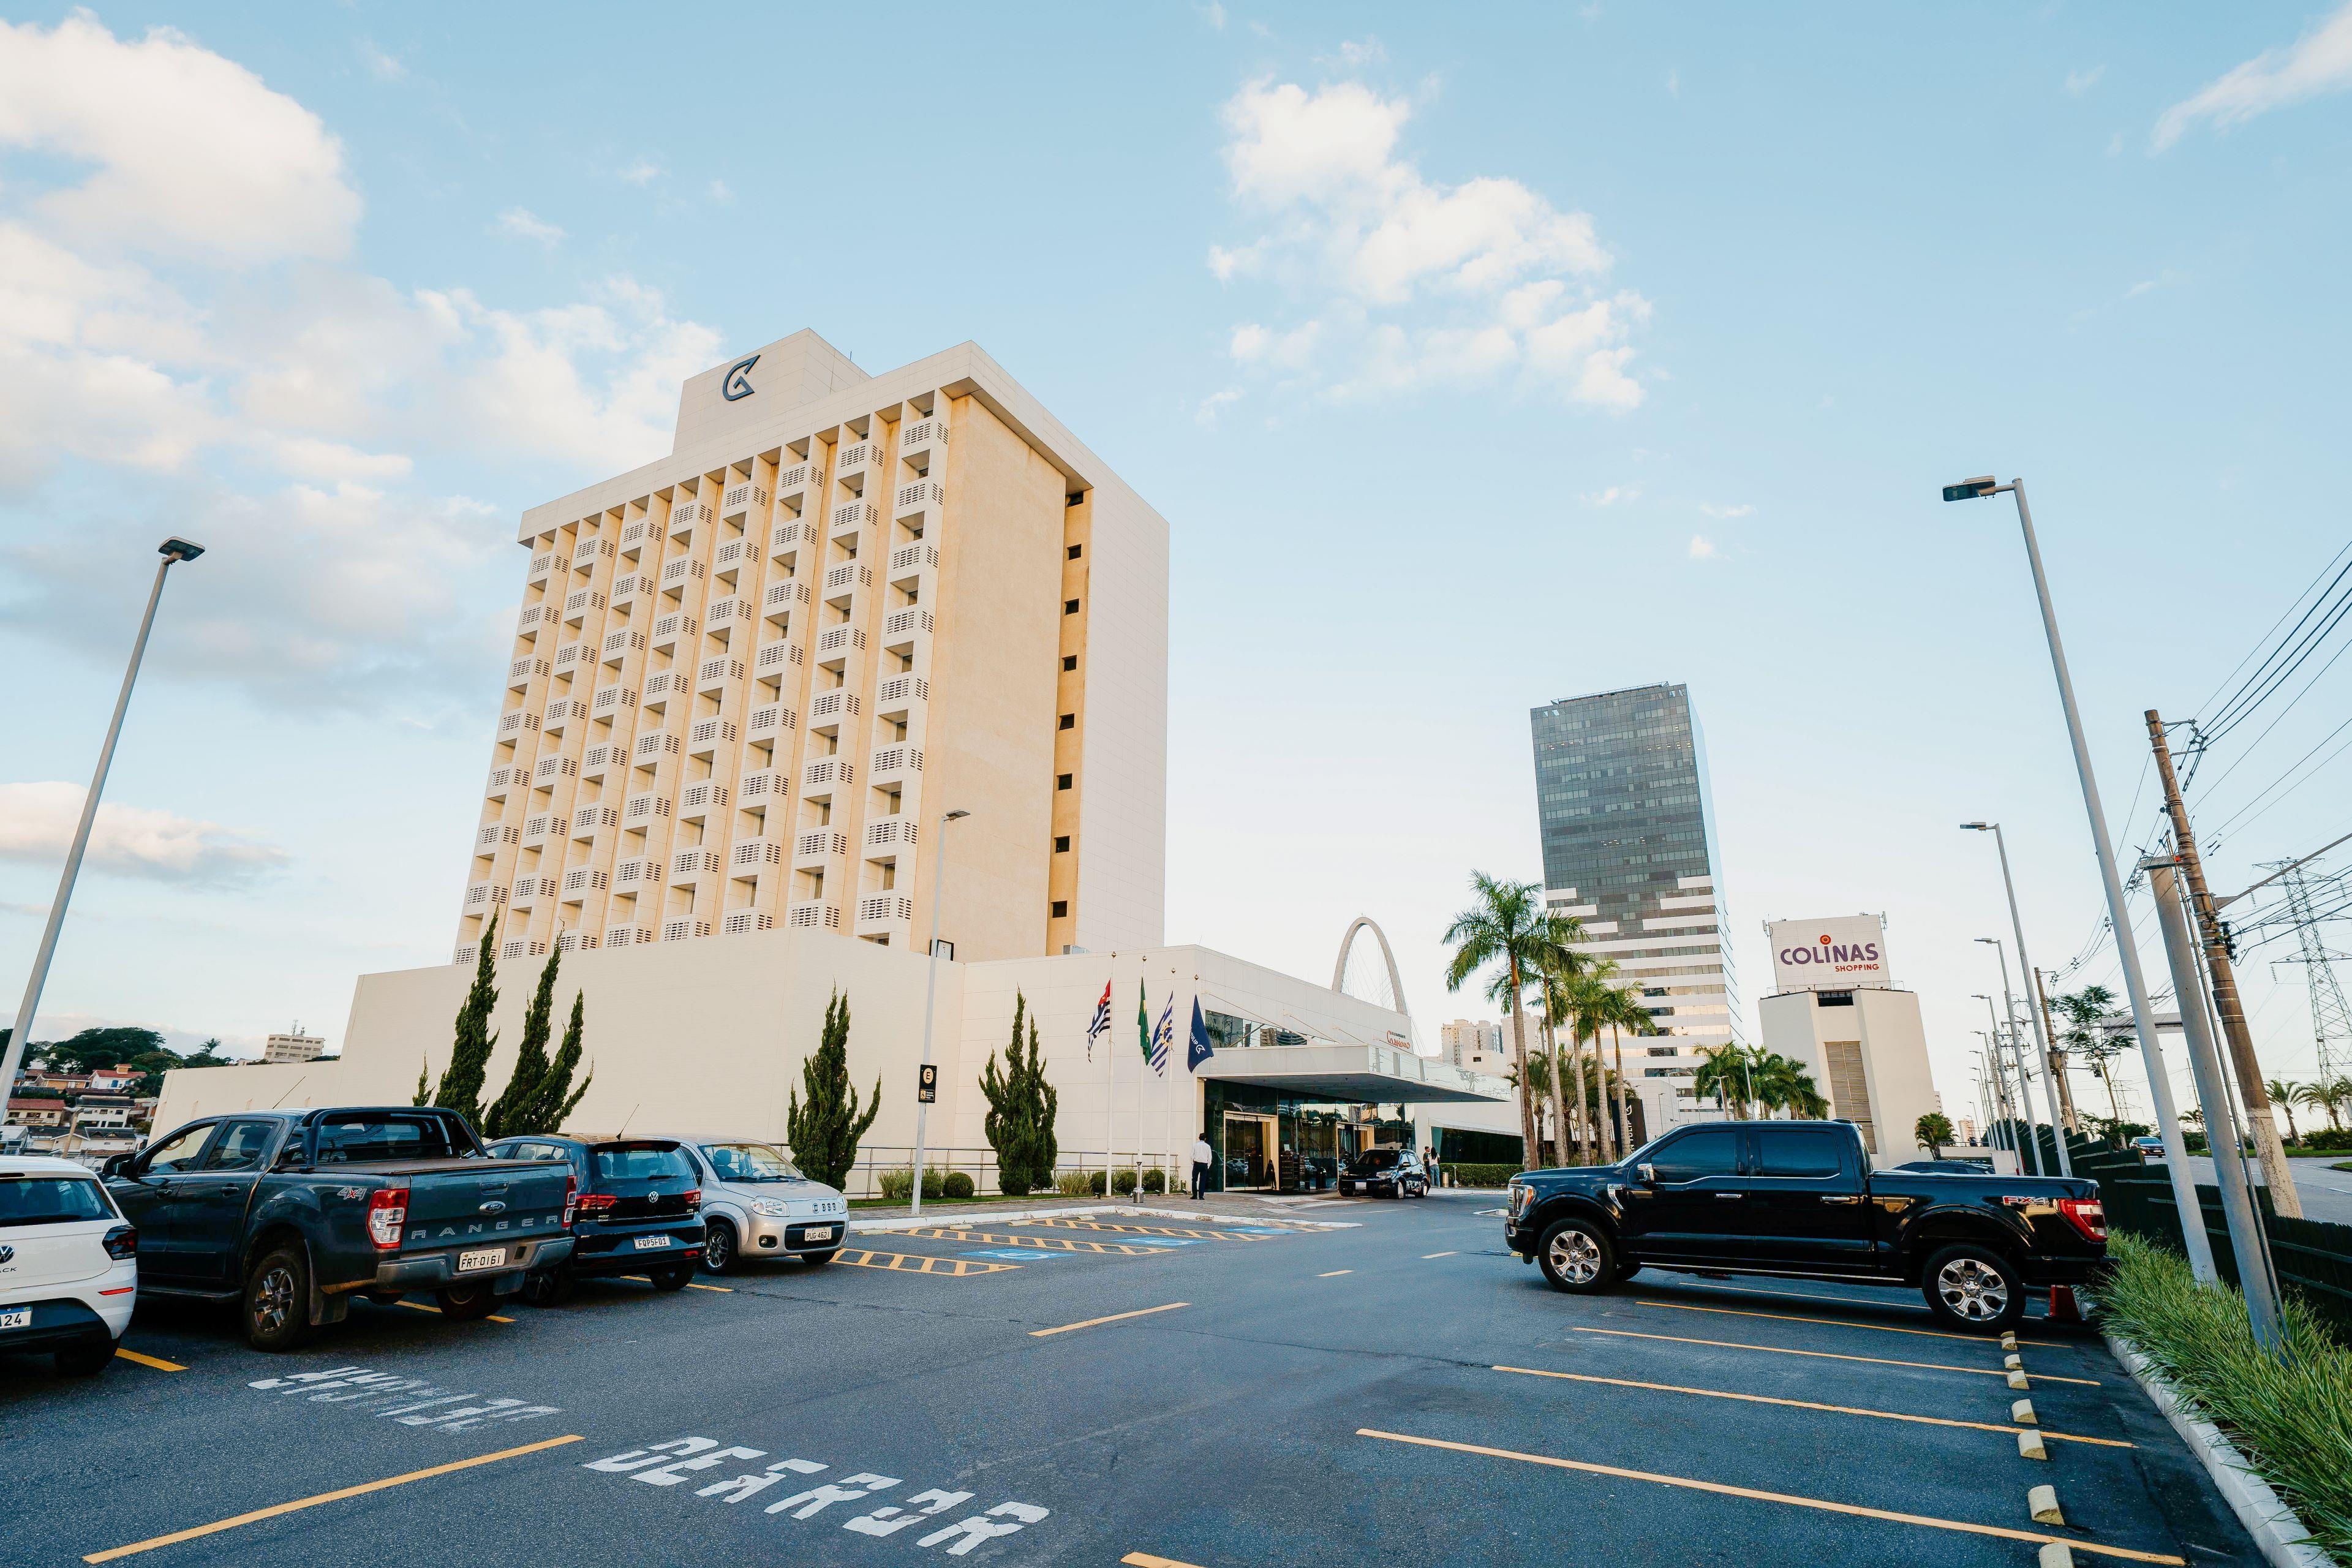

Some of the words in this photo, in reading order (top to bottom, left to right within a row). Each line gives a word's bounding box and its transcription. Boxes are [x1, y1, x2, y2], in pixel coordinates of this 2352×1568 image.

[1780, 943, 1879, 965] COLINAS
[1834, 963, 1880, 973] SHOPPING
[925, 1071, 931, 1080] E
[2002, 1195, 2050, 1207] FX4
[411, 1215, 558, 1240] RANGER
[638, 1237, 667, 1248] FQP5F01
